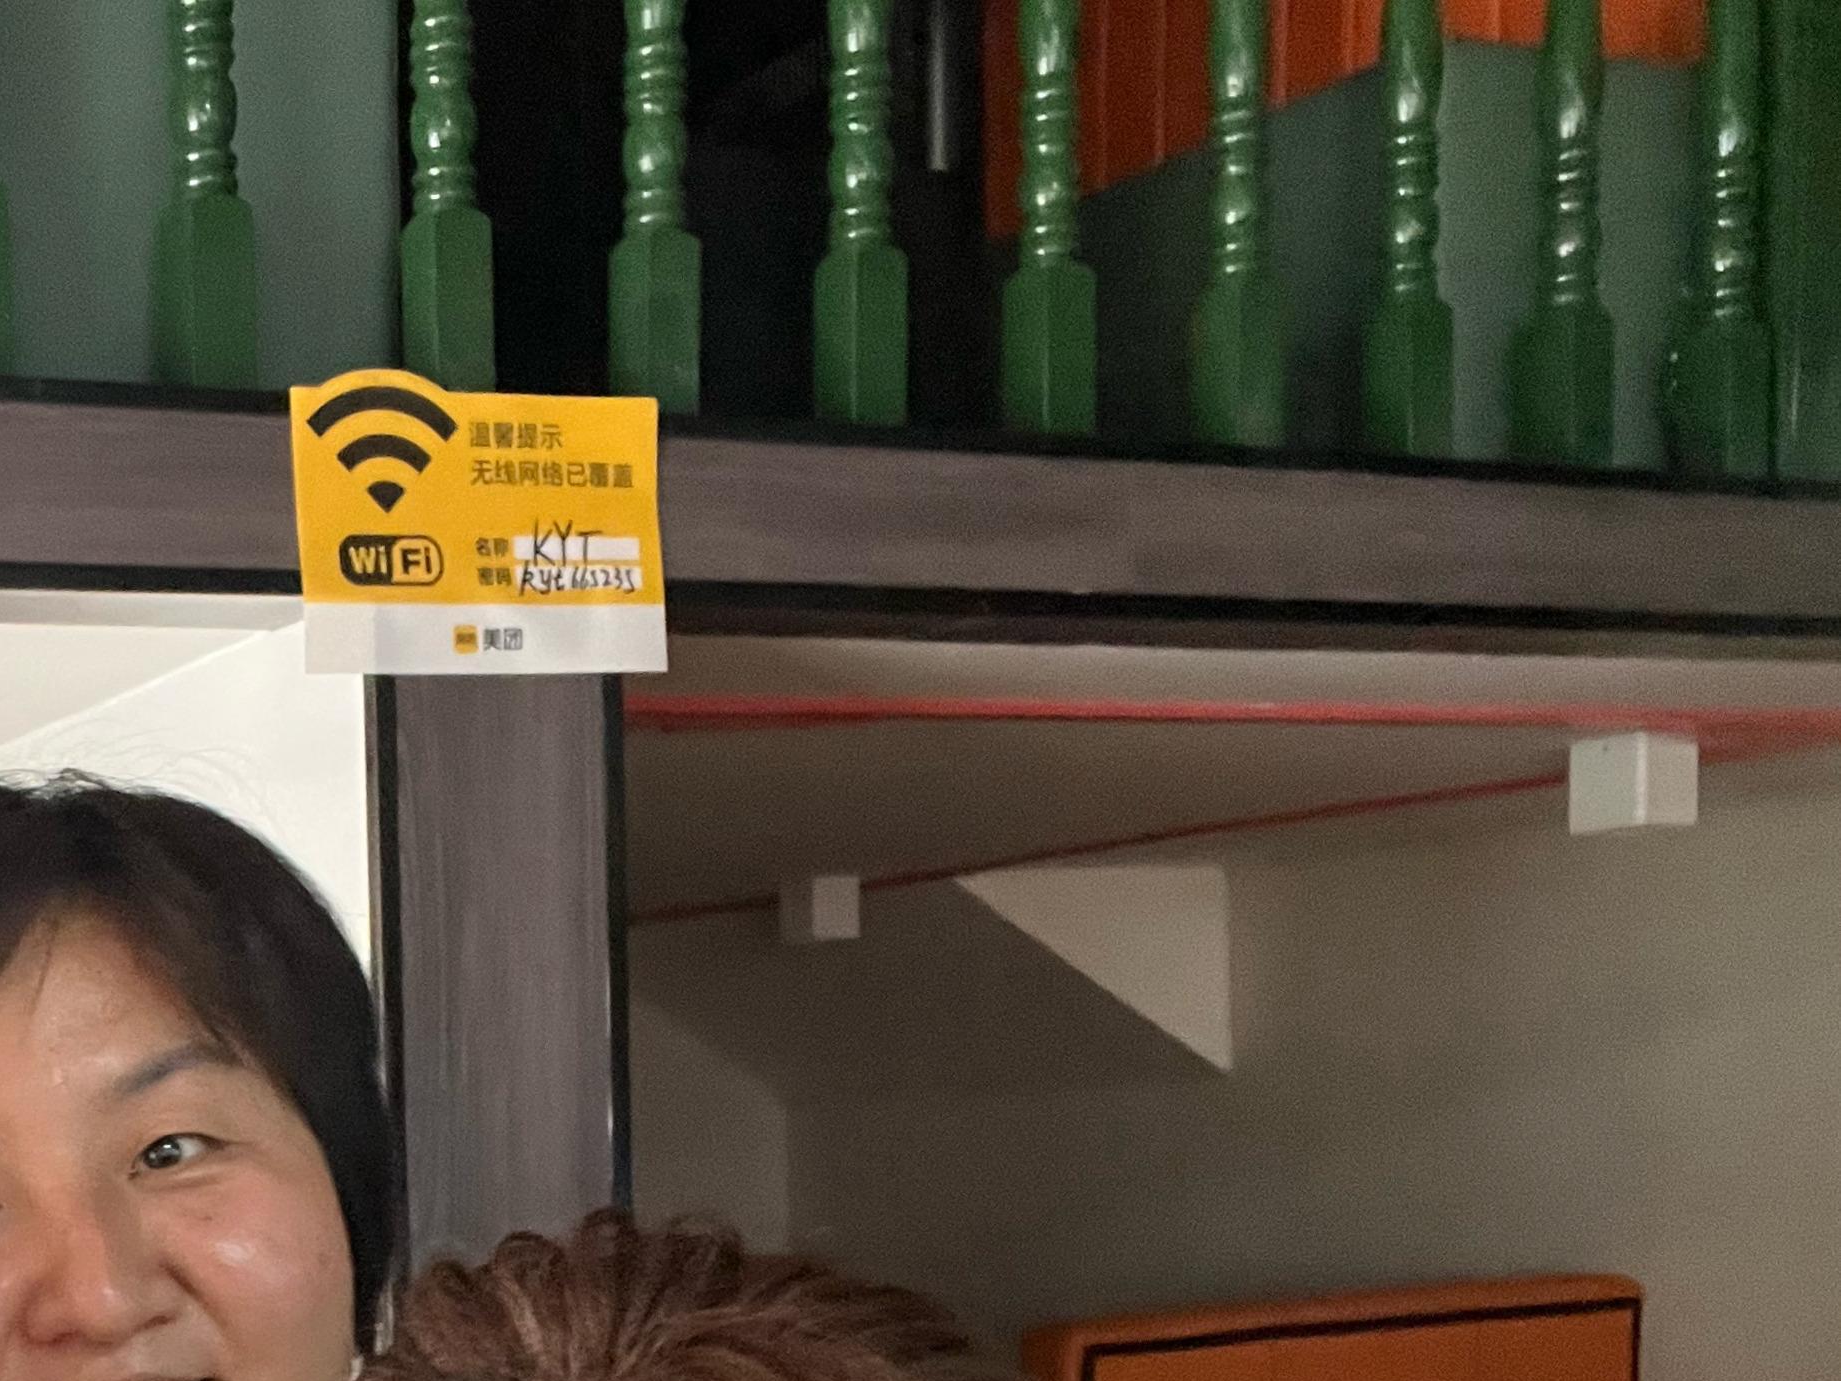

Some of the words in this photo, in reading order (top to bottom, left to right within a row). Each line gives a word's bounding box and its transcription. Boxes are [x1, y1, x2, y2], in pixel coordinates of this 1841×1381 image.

[469, 421, 563, 449] 温馨提示
[470, 459, 634, 488] 无线网络已覆盖
[533, 519, 603, 567] KYT
